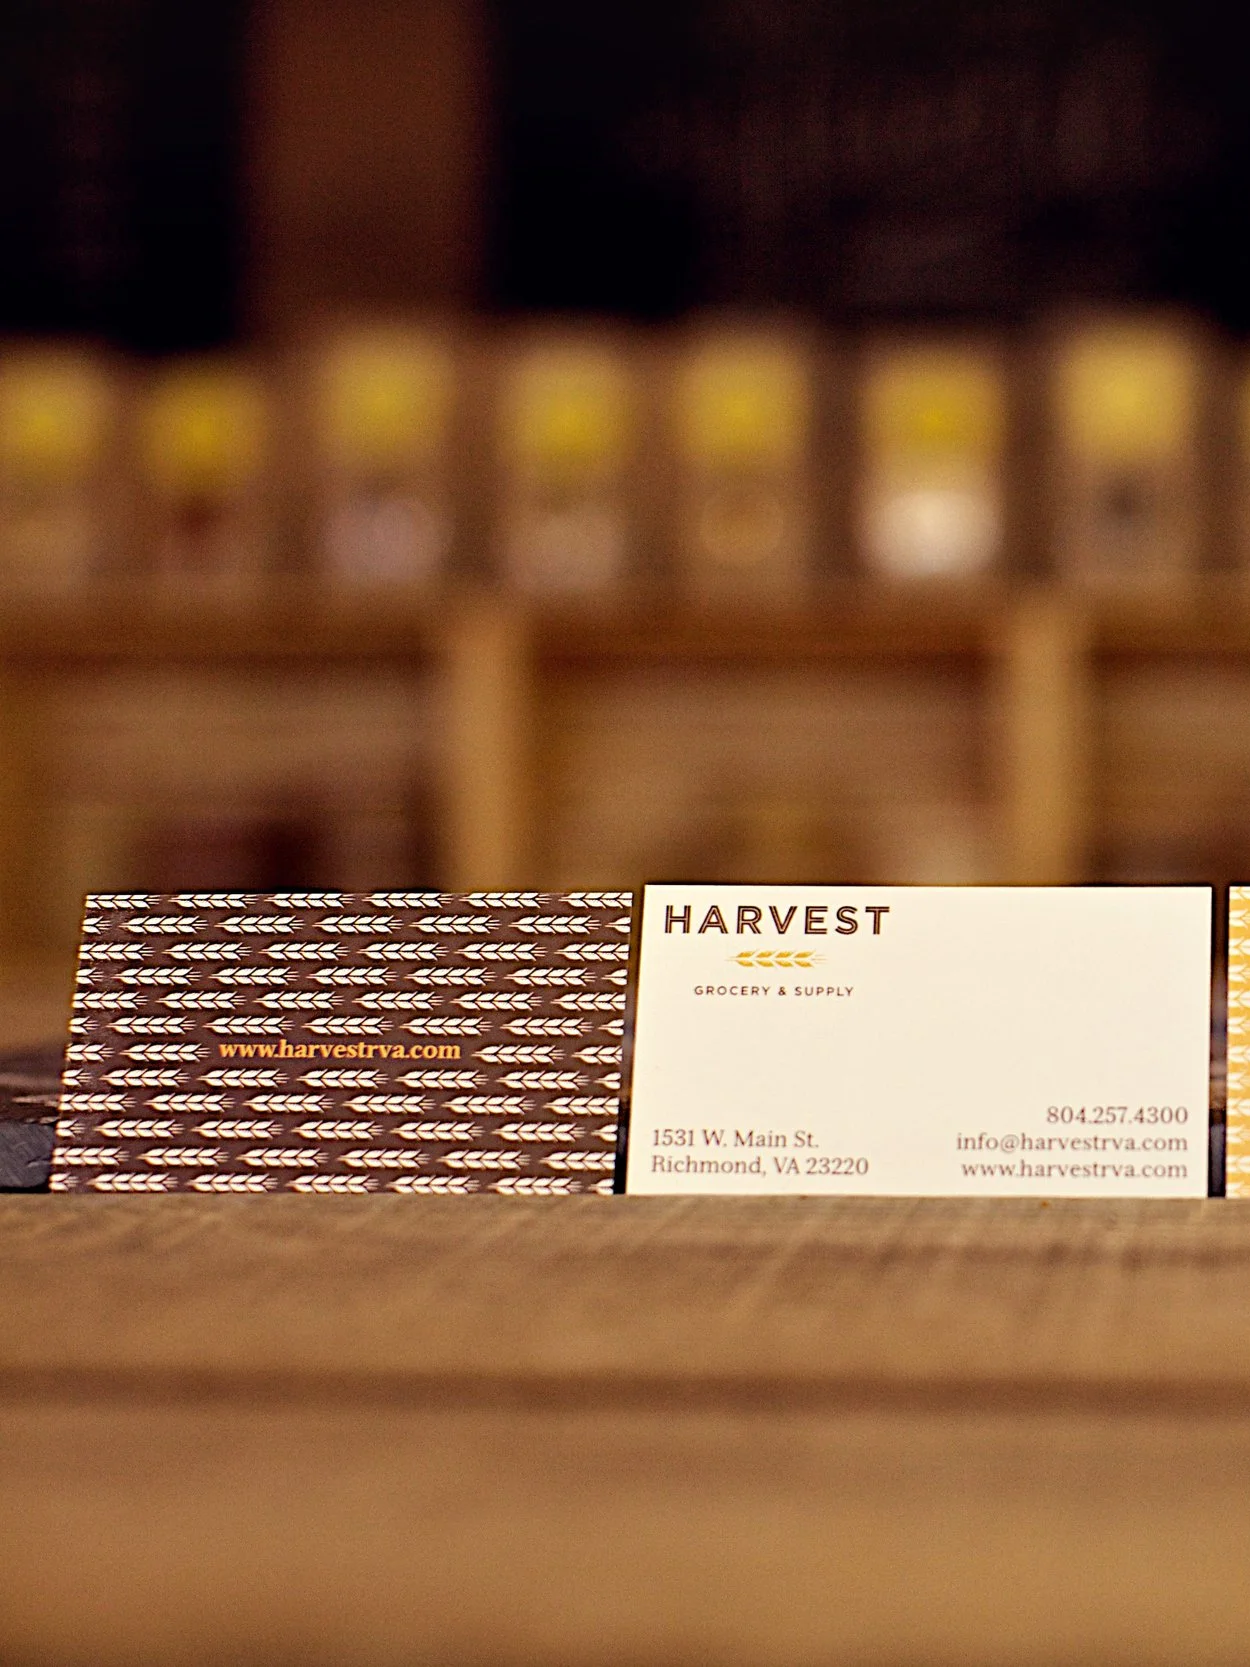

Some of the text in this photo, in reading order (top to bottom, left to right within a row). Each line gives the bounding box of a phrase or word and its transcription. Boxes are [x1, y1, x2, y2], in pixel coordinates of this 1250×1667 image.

[664, 905, 890, 935] HARVEST
[694, 986, 853, 996] GROCERY & SUPPLY
[219, 1039, 462, 1060] www.harvestrva.com
[1047, 1106, 1188, 1124] 804.257.4300
[653, 1129, 818, 1148] 1531 W. Main St.
[957, 1132, 1187, 1153] info@harvestrva.com
[651, 1155, 869, 1176] Richmond, VA 23220
[962, 1159, 1187, 1178] www.harvestrva.com
